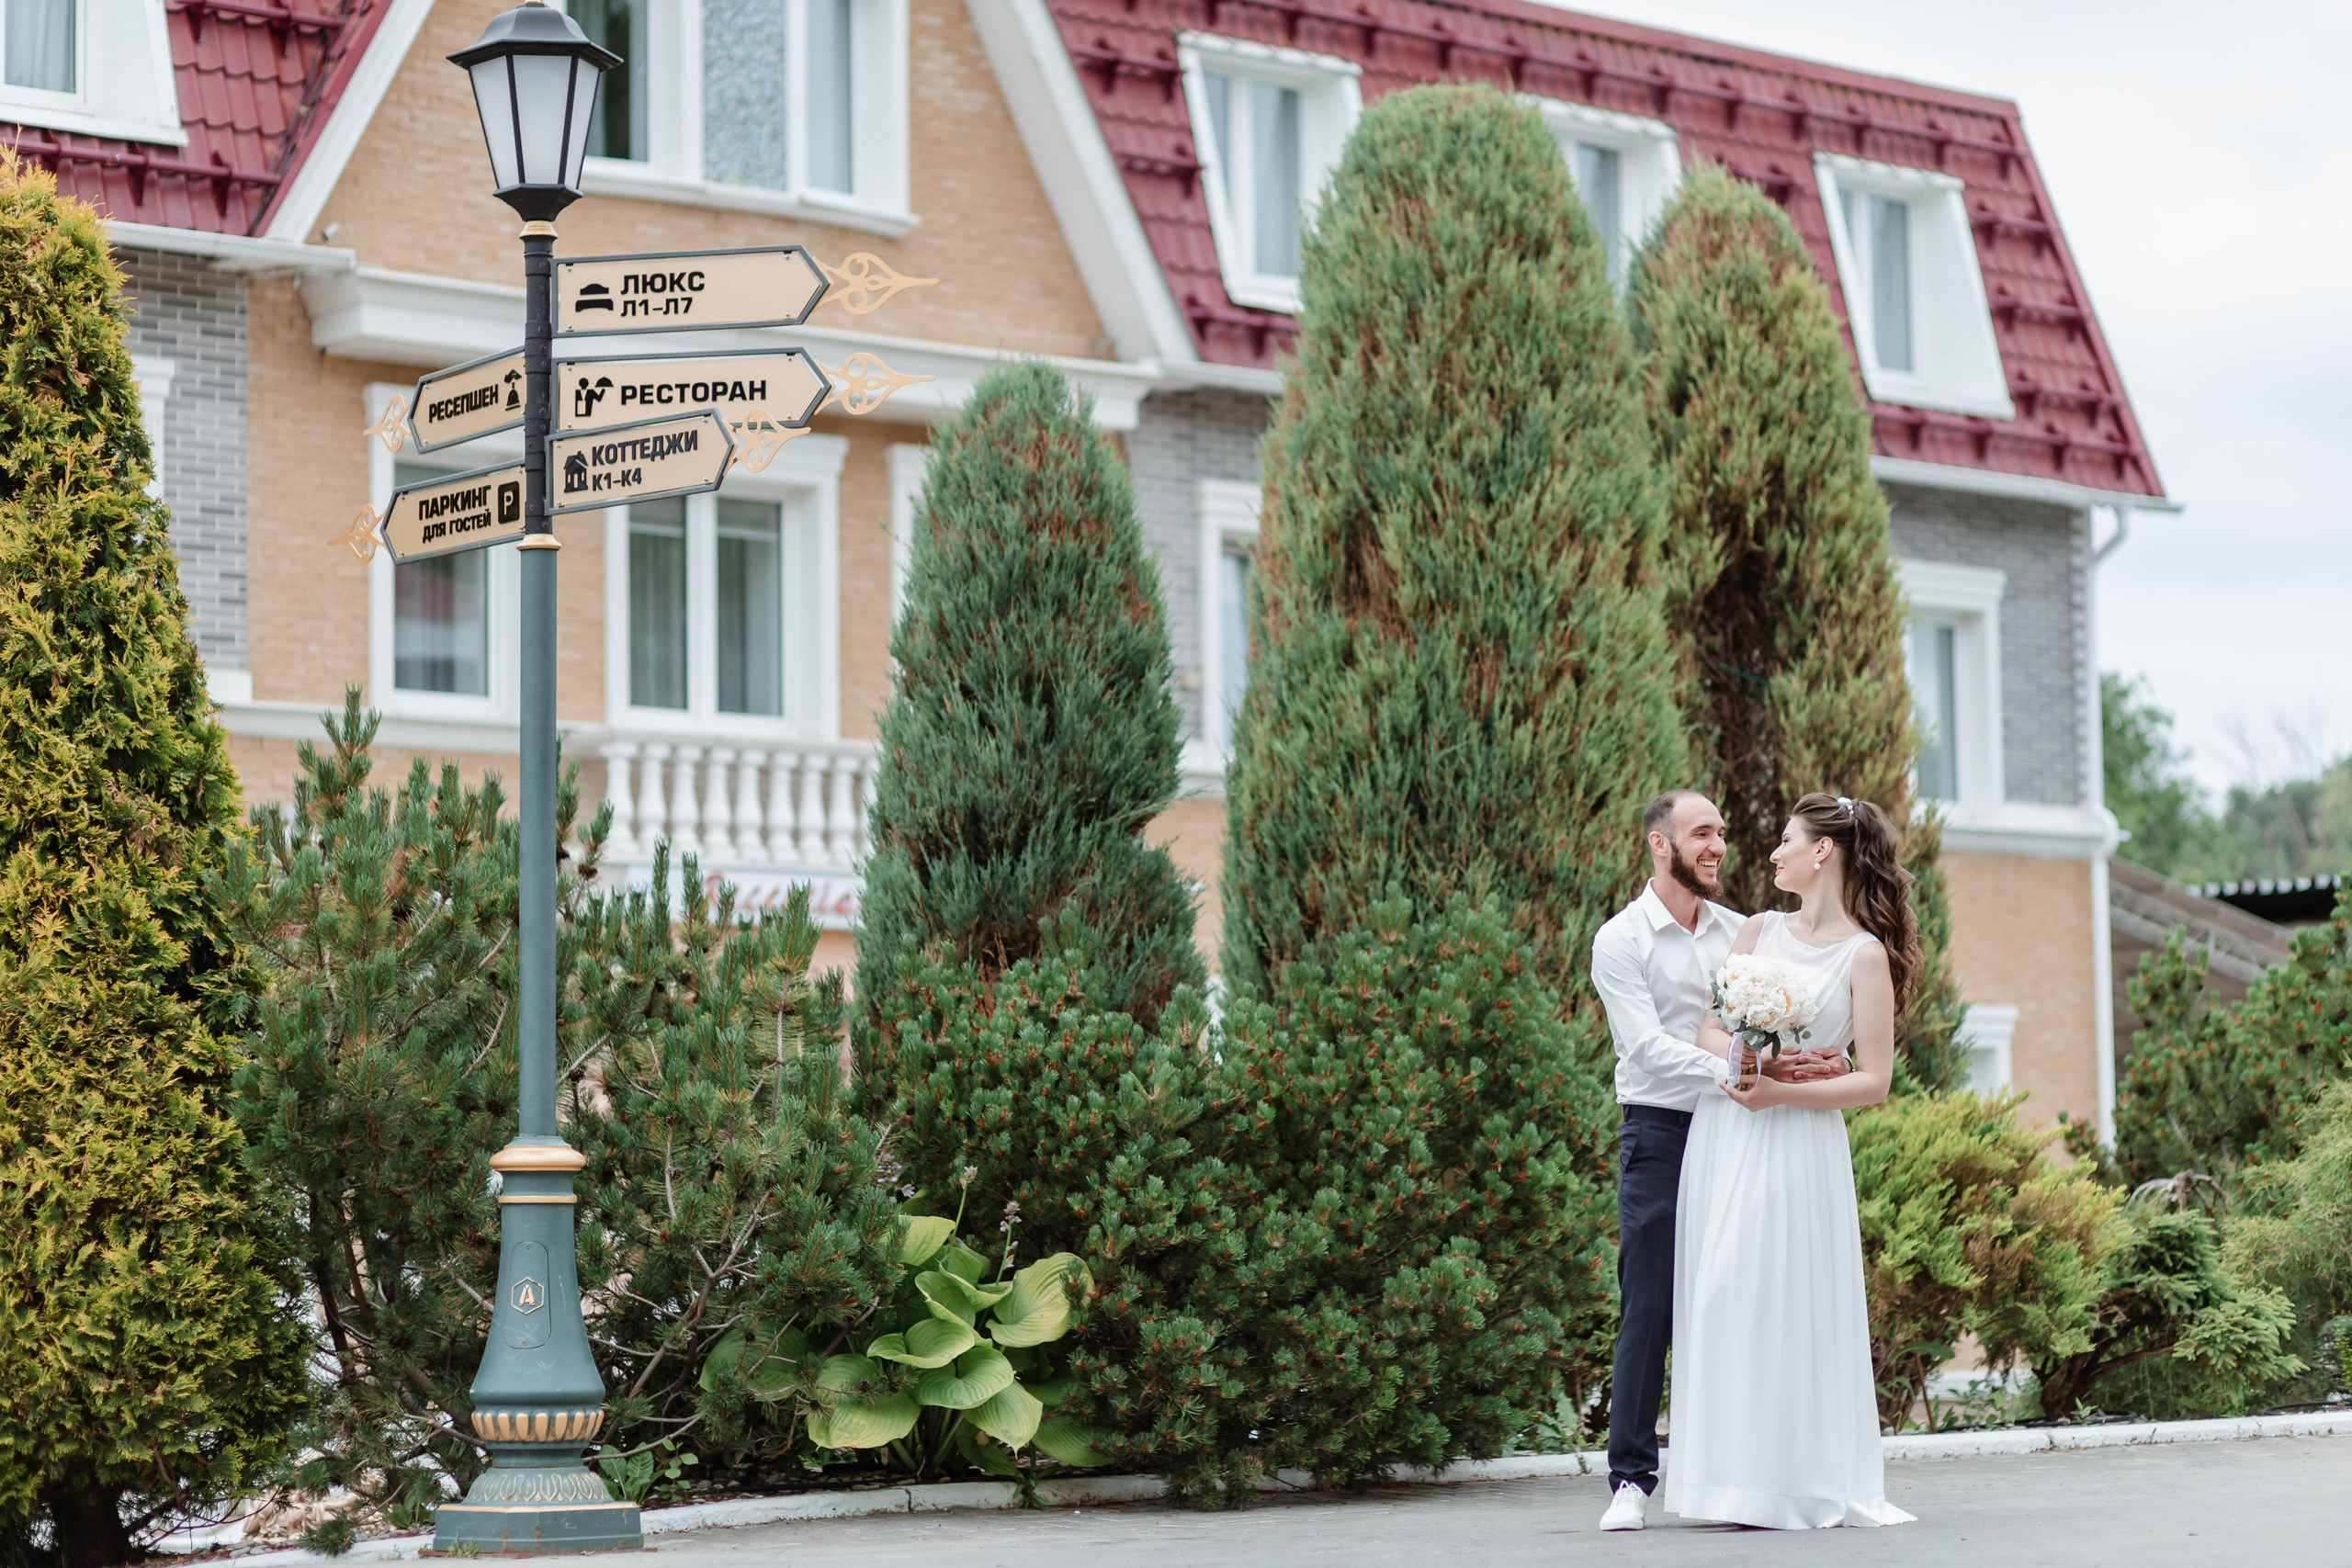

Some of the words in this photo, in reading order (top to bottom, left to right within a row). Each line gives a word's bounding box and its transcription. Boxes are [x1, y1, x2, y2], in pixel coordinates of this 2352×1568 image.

[620, 271, 705, 295] ЛЮКС
[428, 384, 499, 423] РЕСЕПШЕН
[621, 379, 766, 405] РЕСТОРАН
[592, 430, 698, 467] КОТТЕДЖИ
[418, 484, 492, 521] ПАРКИНГ
[422, 521, 447, 544] ДЛЯ
[448, 508, 492, 536] ГОСТЕЙ
